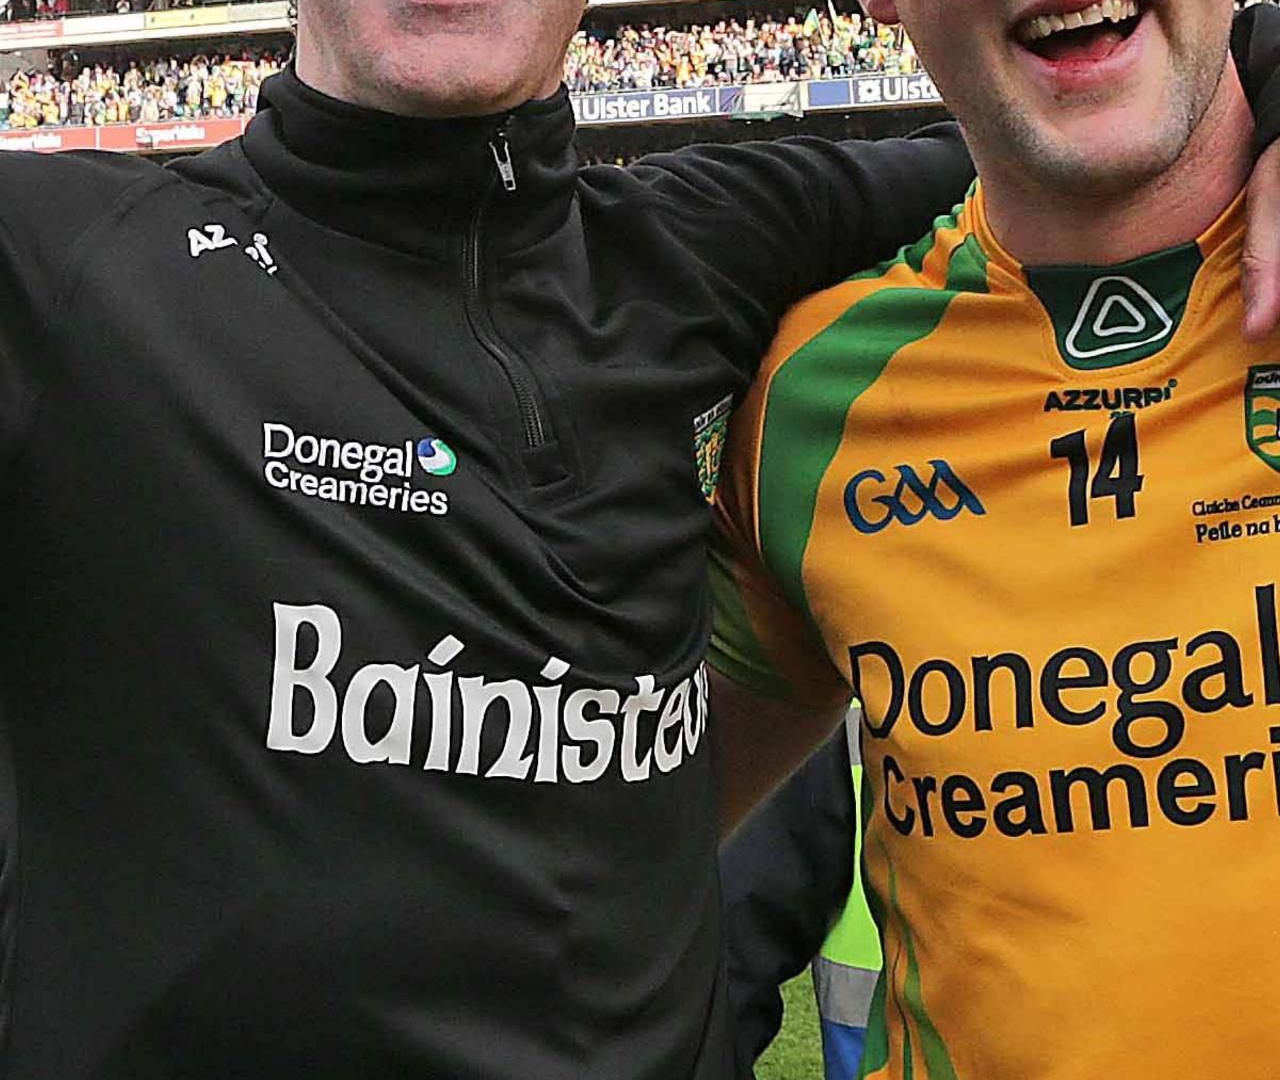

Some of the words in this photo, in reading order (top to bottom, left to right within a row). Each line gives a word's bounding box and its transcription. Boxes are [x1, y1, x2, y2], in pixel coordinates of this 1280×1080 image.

[583, 96, 650, 119] Ulster
[653, 92, 712, 116] Bank
[1043, 384, 1176, 412] AZZURRI
[263, 422, 413, 483] Donegal
[1050, 412, 1144, 527] 14
[264, 461, 449, 515] Creameries
[844, 460, 986, 534] GAA
[1246, 521, 1270, 536] na
